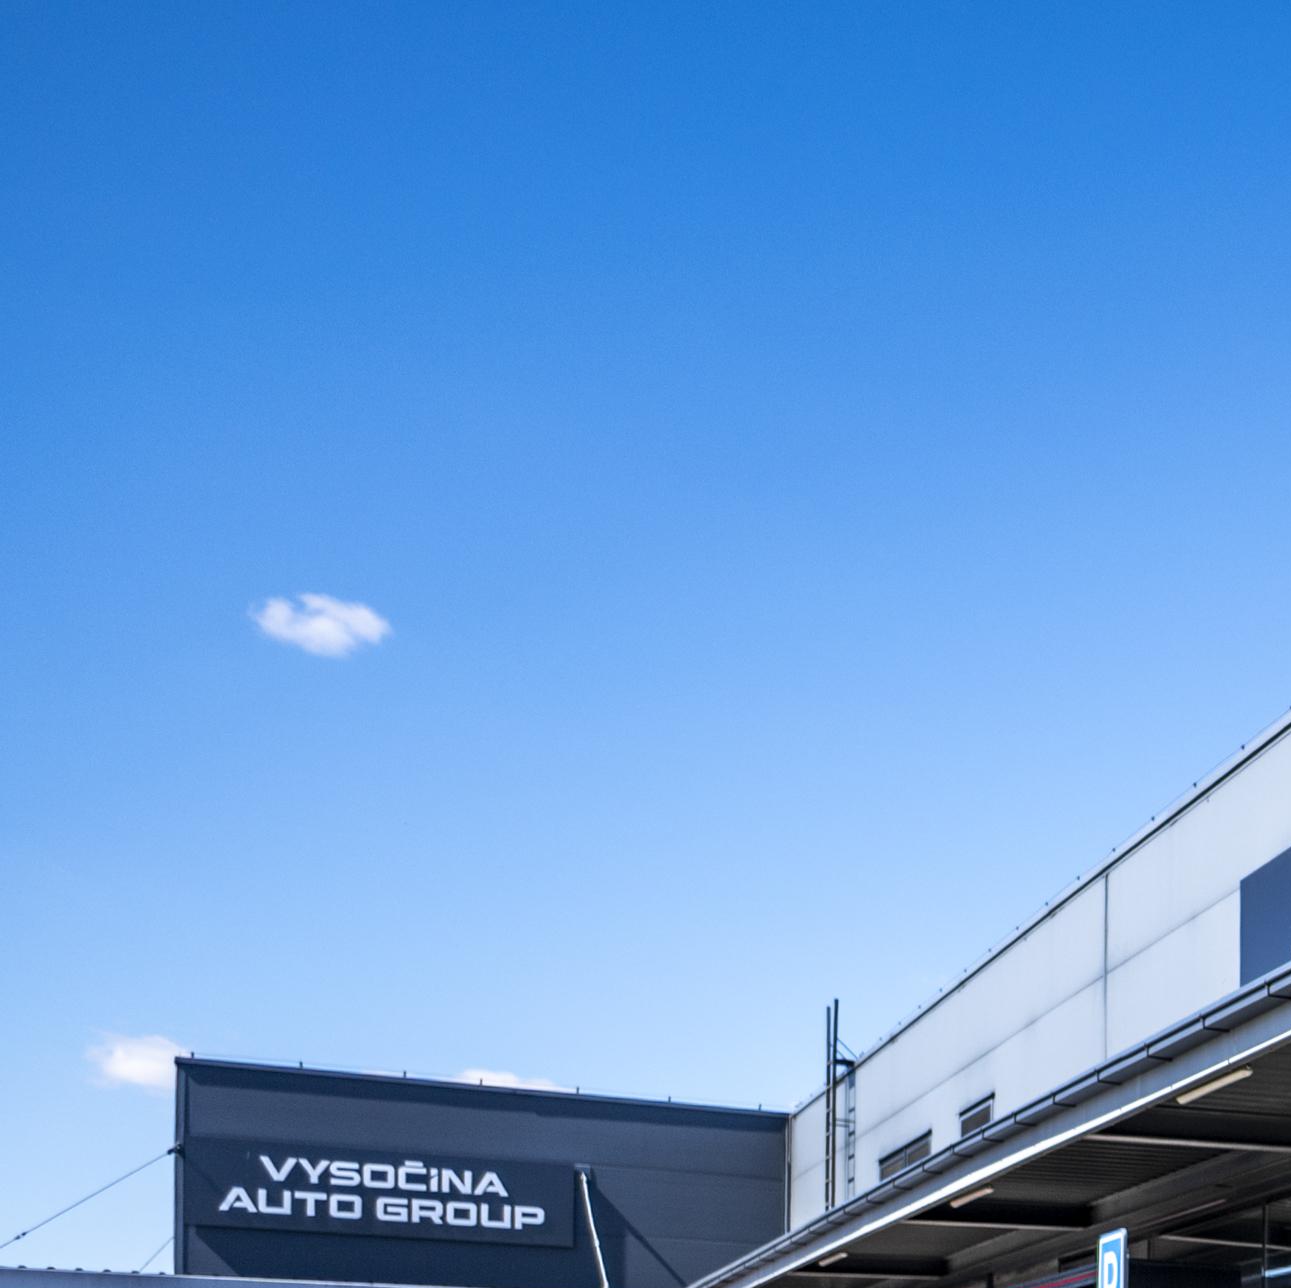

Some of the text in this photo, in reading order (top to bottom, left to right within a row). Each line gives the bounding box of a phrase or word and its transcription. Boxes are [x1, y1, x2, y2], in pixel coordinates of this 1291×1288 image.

[259, 1155, 509, 1198] VYSOČINA
[219, 1186, 545, 1230] AUTO GROUP
